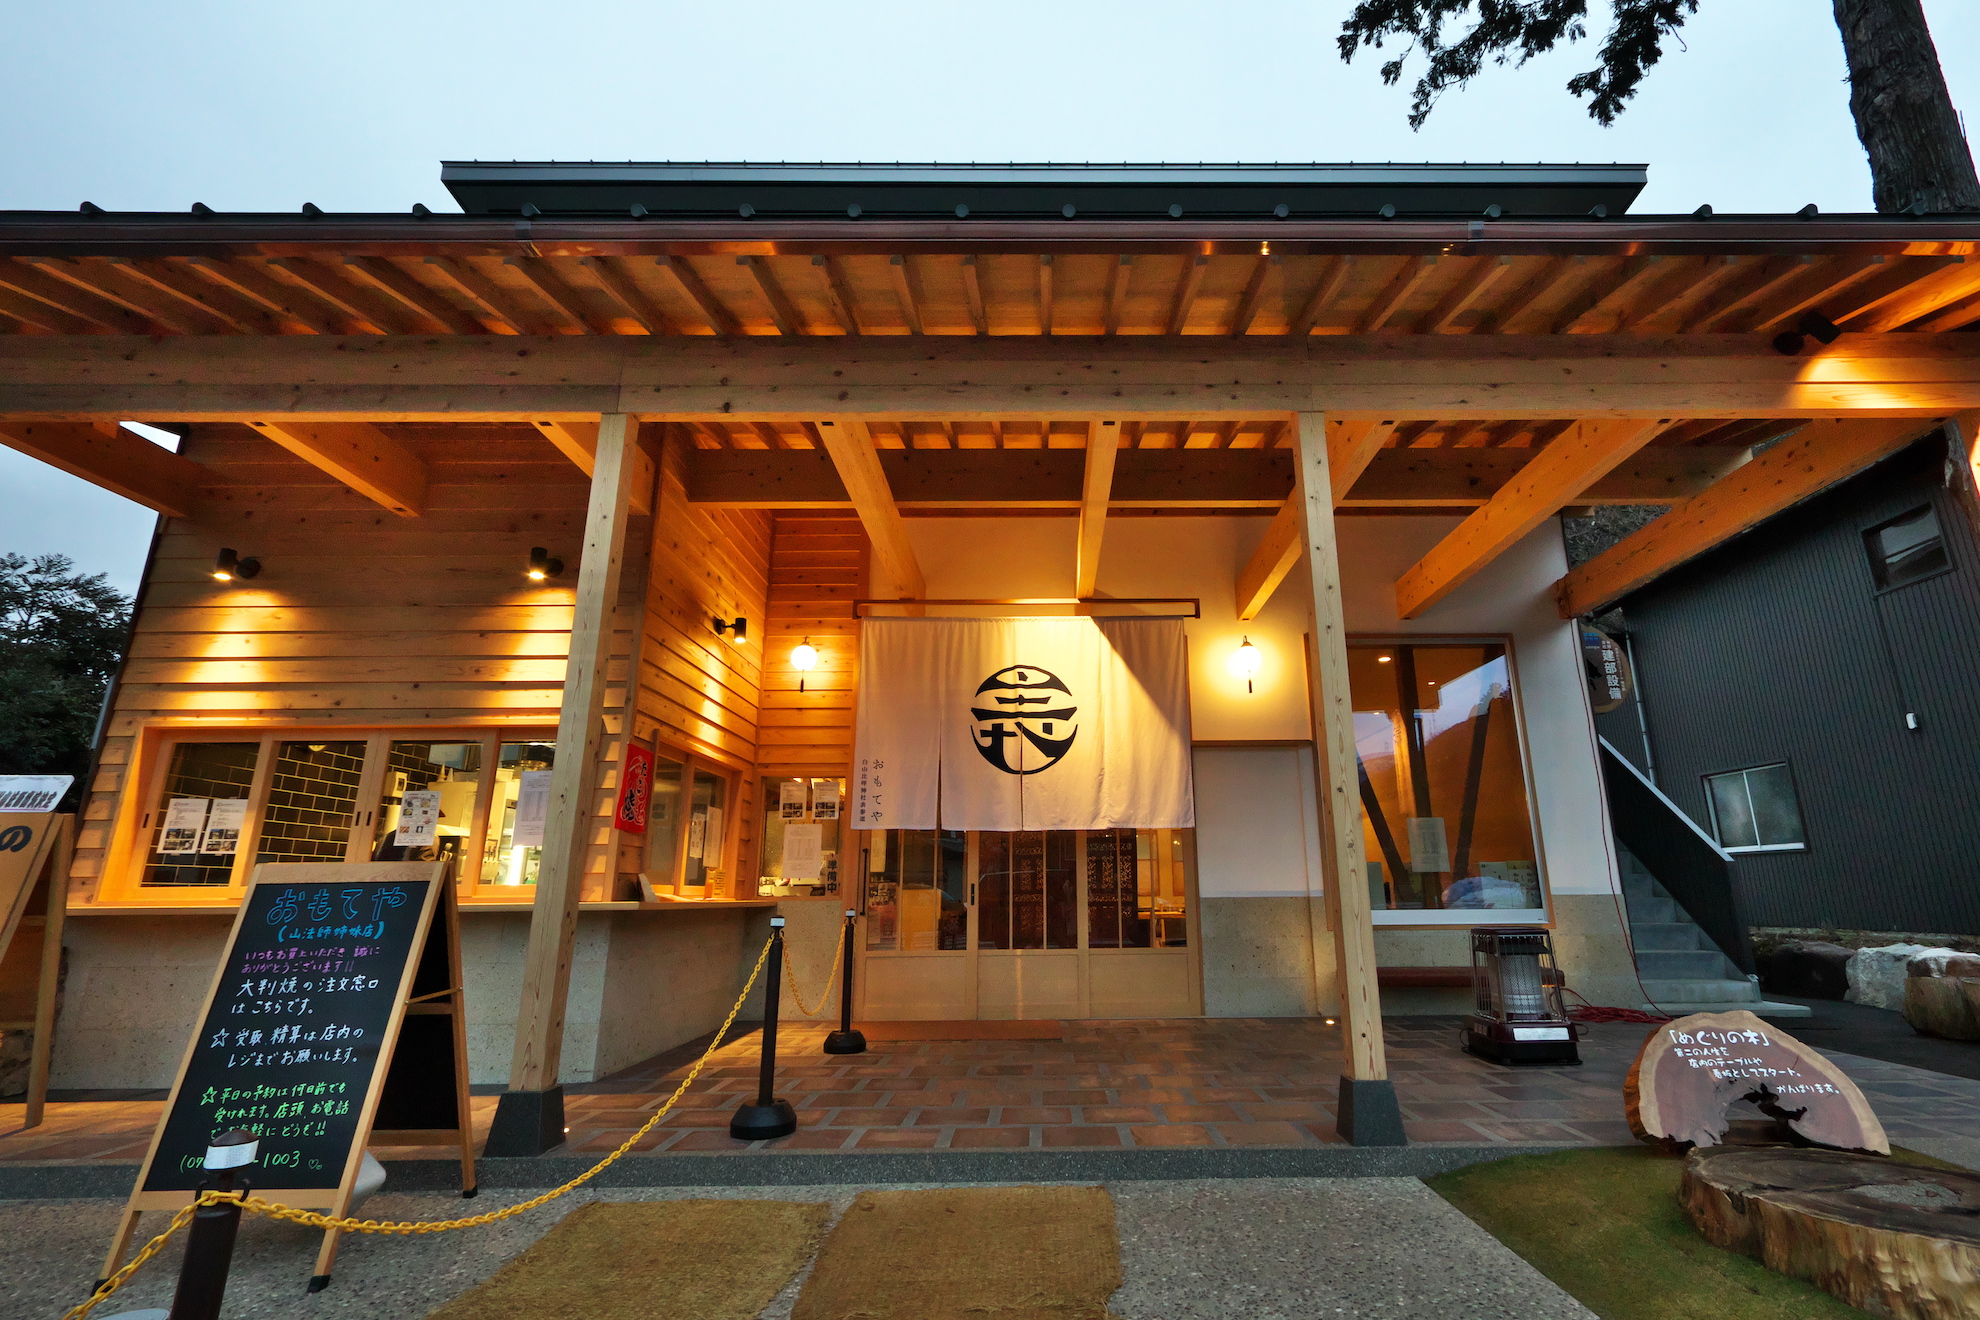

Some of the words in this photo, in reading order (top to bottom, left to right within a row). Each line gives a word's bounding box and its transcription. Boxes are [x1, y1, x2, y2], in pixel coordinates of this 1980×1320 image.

[871, 759, 884, 822] おもてや
[827, 860, 838, 893] 準備中
[267, 886, 407, 925] おもてや
[236, 974, 379, 998] 大判焼の注文窓口
